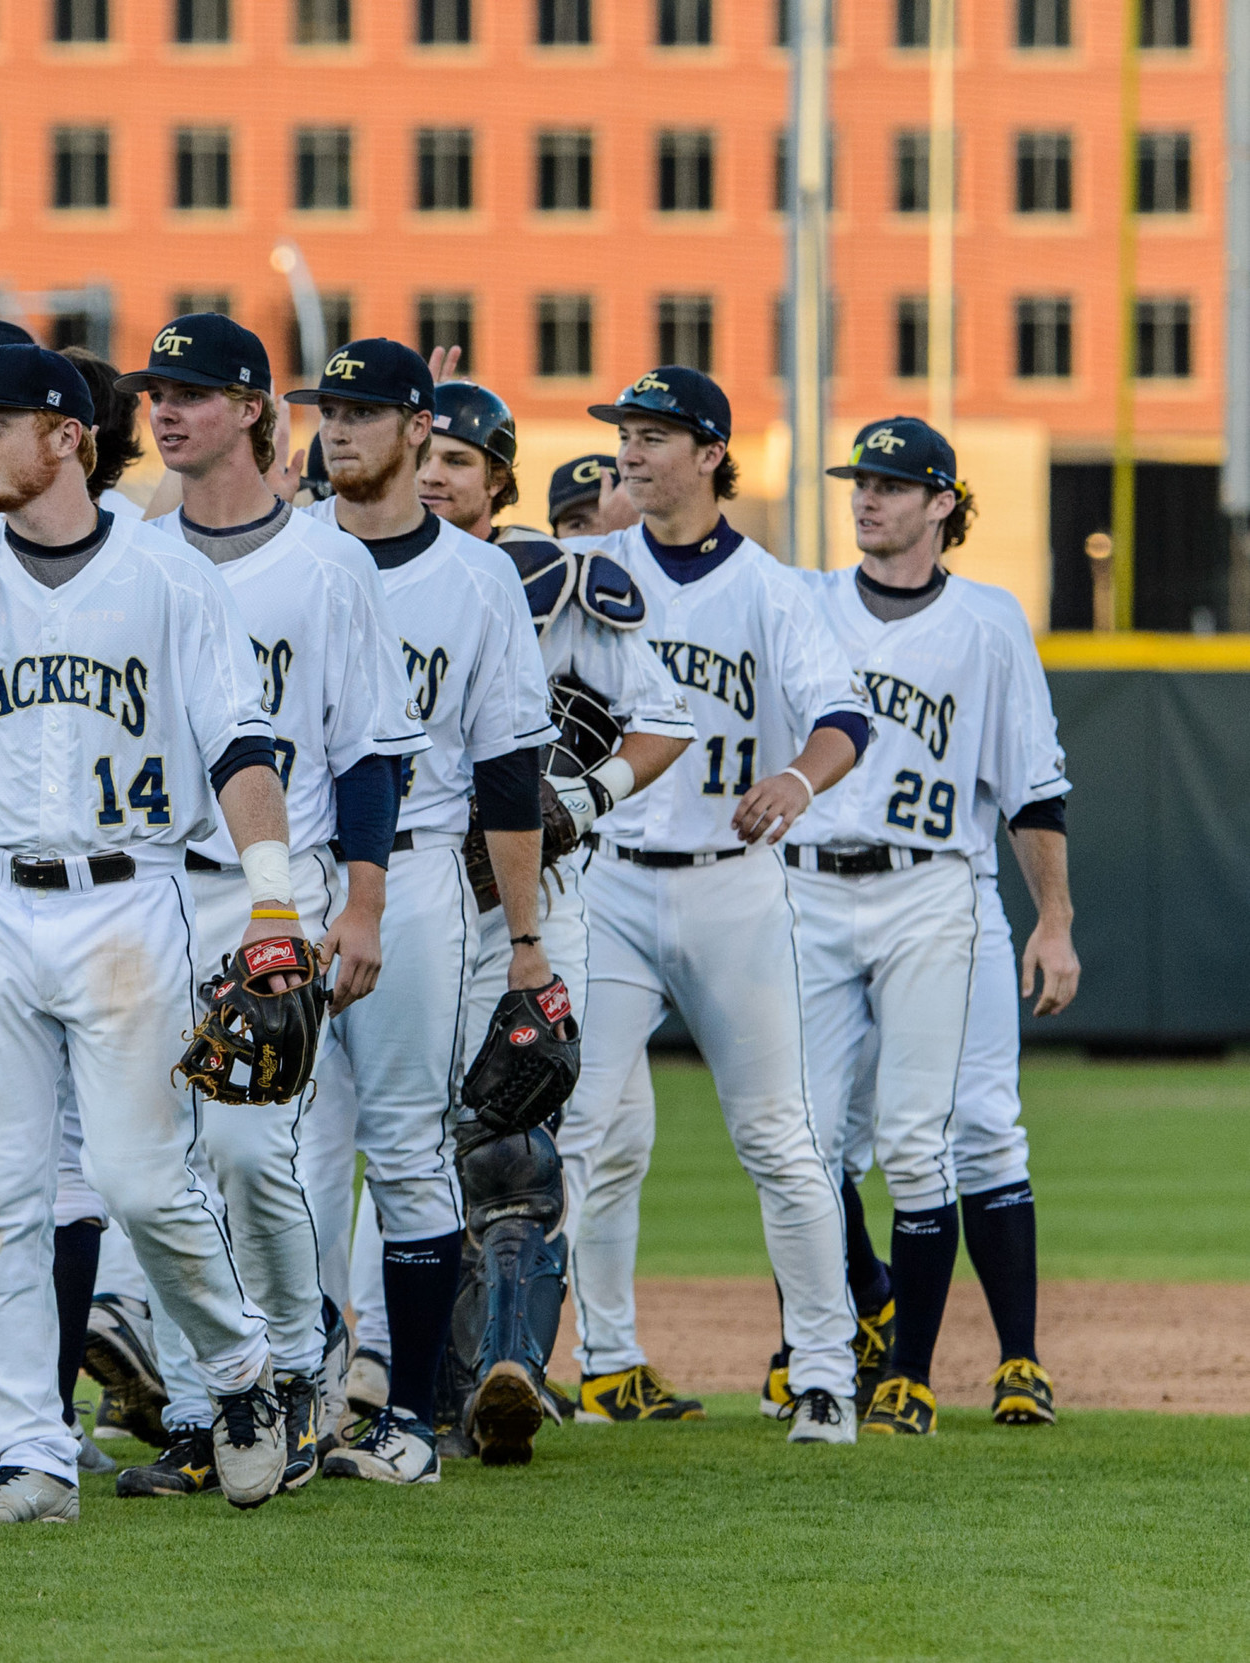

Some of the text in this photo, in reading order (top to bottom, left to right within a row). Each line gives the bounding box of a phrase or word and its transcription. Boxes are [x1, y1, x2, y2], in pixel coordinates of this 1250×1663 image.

[153, 326, 193, 356] GT
[324, 350, 366, 380] GT
[866, 427, 906, 455] GT
[647, 639, 757, 722] KETS
[853, 670, 957, 762] KETS
[92, 755, 173, 828] 14
[702, 736, 757, 798] 11
[884, 767, 957, 843] 29
[252, 944, 291, 967] Rawlings
[258, 1042, 277, 1088] Rawlings
